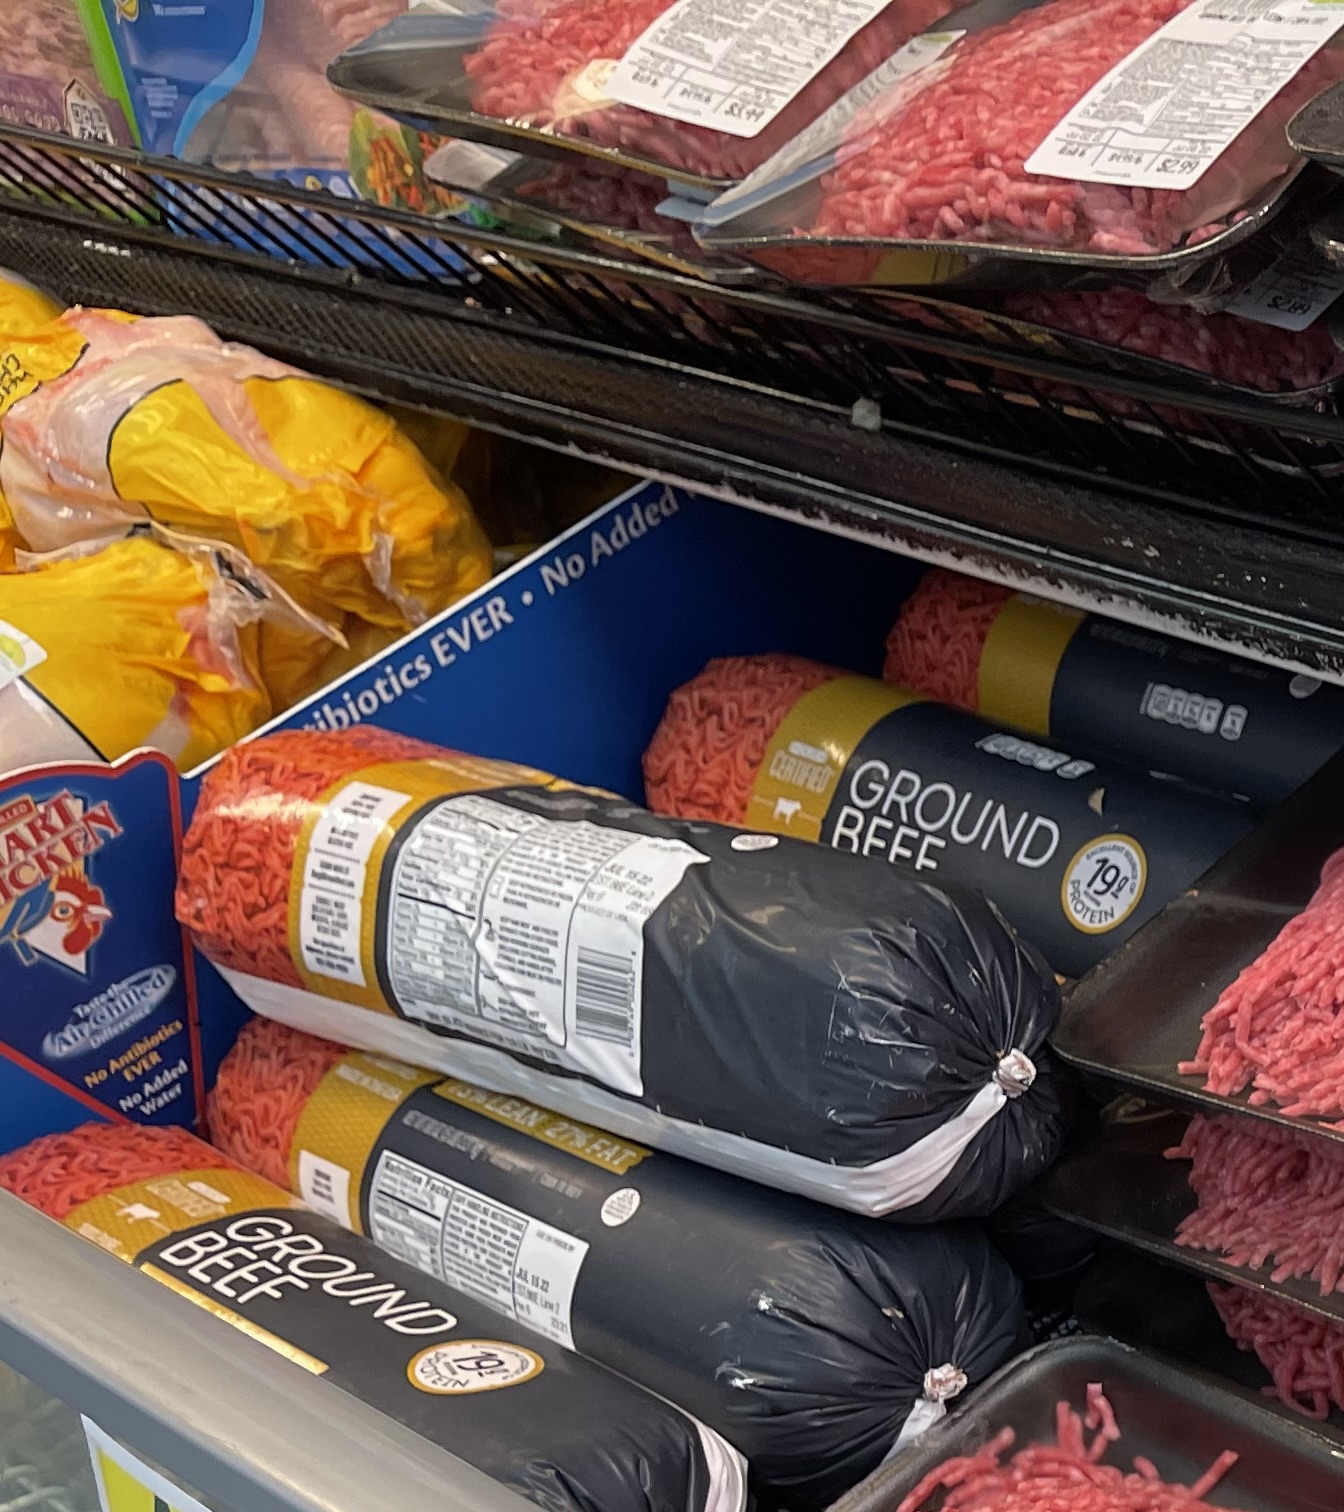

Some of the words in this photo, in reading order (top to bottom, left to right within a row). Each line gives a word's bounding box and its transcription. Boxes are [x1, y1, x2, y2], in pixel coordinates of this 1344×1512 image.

[429, 595, 514, 669] EVER
[539, 552, 586, 596] No
[589, 484, 679, 568] Added
[768, 750, 837, 794] CERTIFIED
[849, 759, 1061, 868] GROUND
[1070, 879, 1115, 924] PROTEIN
[84, 1069, 108, 1088] No
[110, 1019, 183, 1074] Antibiotics
[119, 1093, 142, 1112] No
[144, 1058, 188, 1098] Added
[139, 1083, 182, 1115] Water
[484, 1094, 547, 1129] LEAN
[544, 1121, 593, 1147] 27%
[585, 1137, 638, 1166] FAT
[158, 1230, 309, 1305] BEEF
[225, 1214, 458, 1337] GROUND
